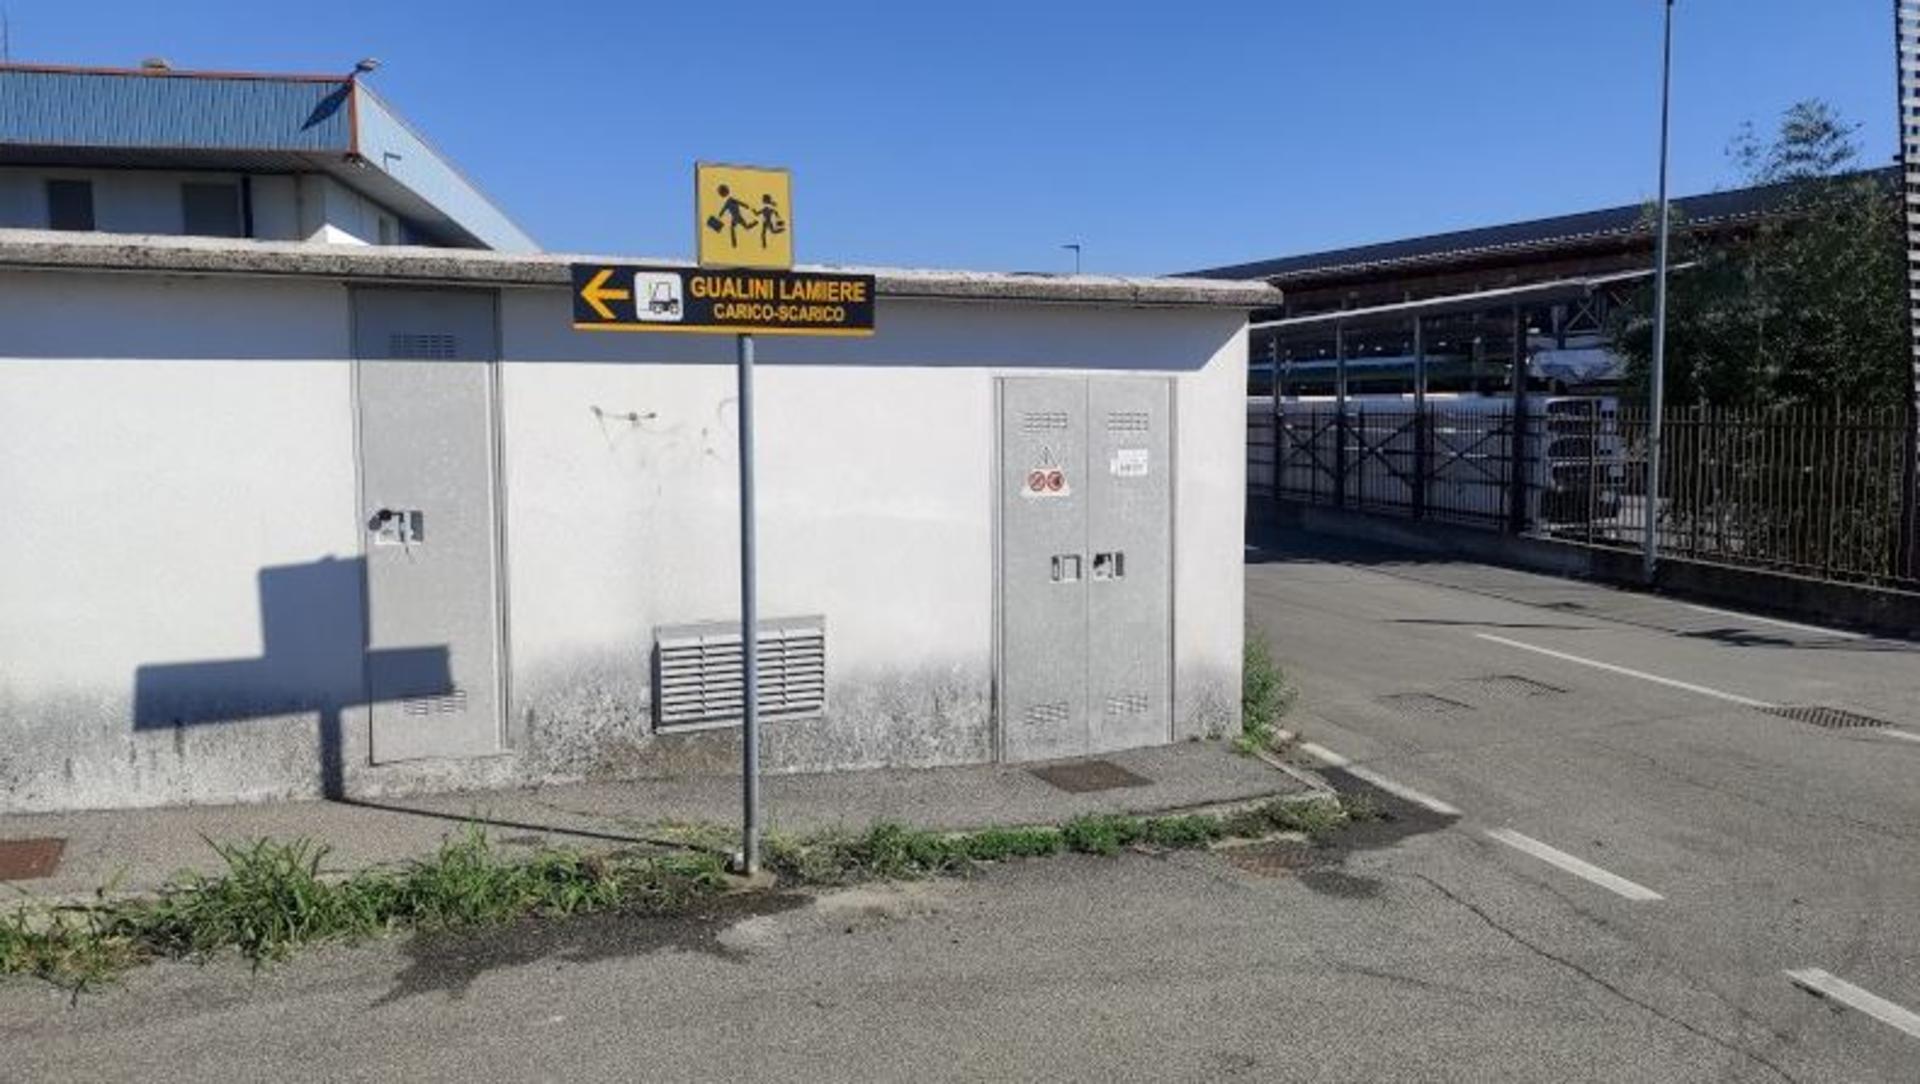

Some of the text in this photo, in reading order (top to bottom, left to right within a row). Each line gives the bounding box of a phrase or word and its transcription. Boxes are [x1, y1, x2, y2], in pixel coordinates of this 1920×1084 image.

[690, 276, 866, 302] GUALINI LAMIERE
[713, 303, 845, 322] CARICO-SCARICO
